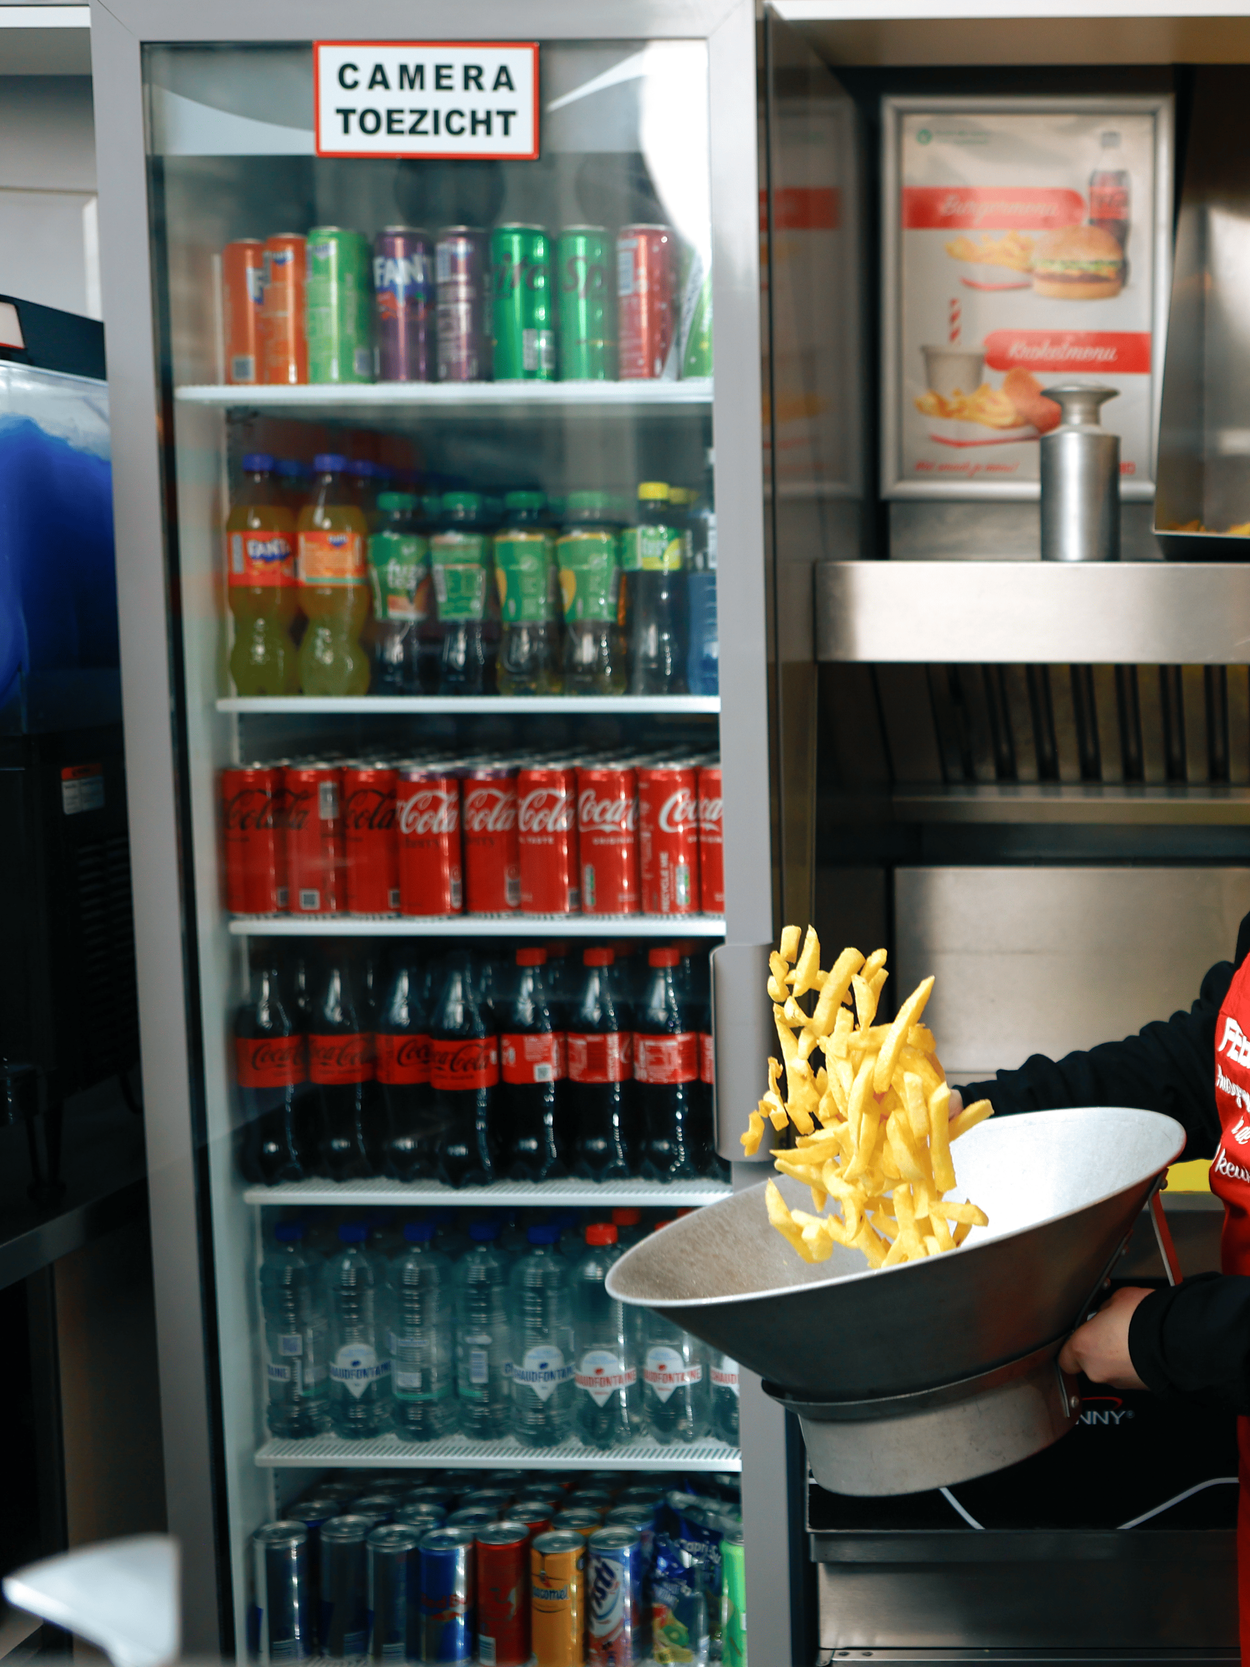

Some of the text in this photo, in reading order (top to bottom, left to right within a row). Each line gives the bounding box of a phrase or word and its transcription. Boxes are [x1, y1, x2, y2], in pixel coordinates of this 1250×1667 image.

[338, 63, 516, 91] CAMERA
[336, 107, 517, 137] TOEZICHT
[400, 788, 459, 835] Cola
[518, 787, 575, 833] Cola
